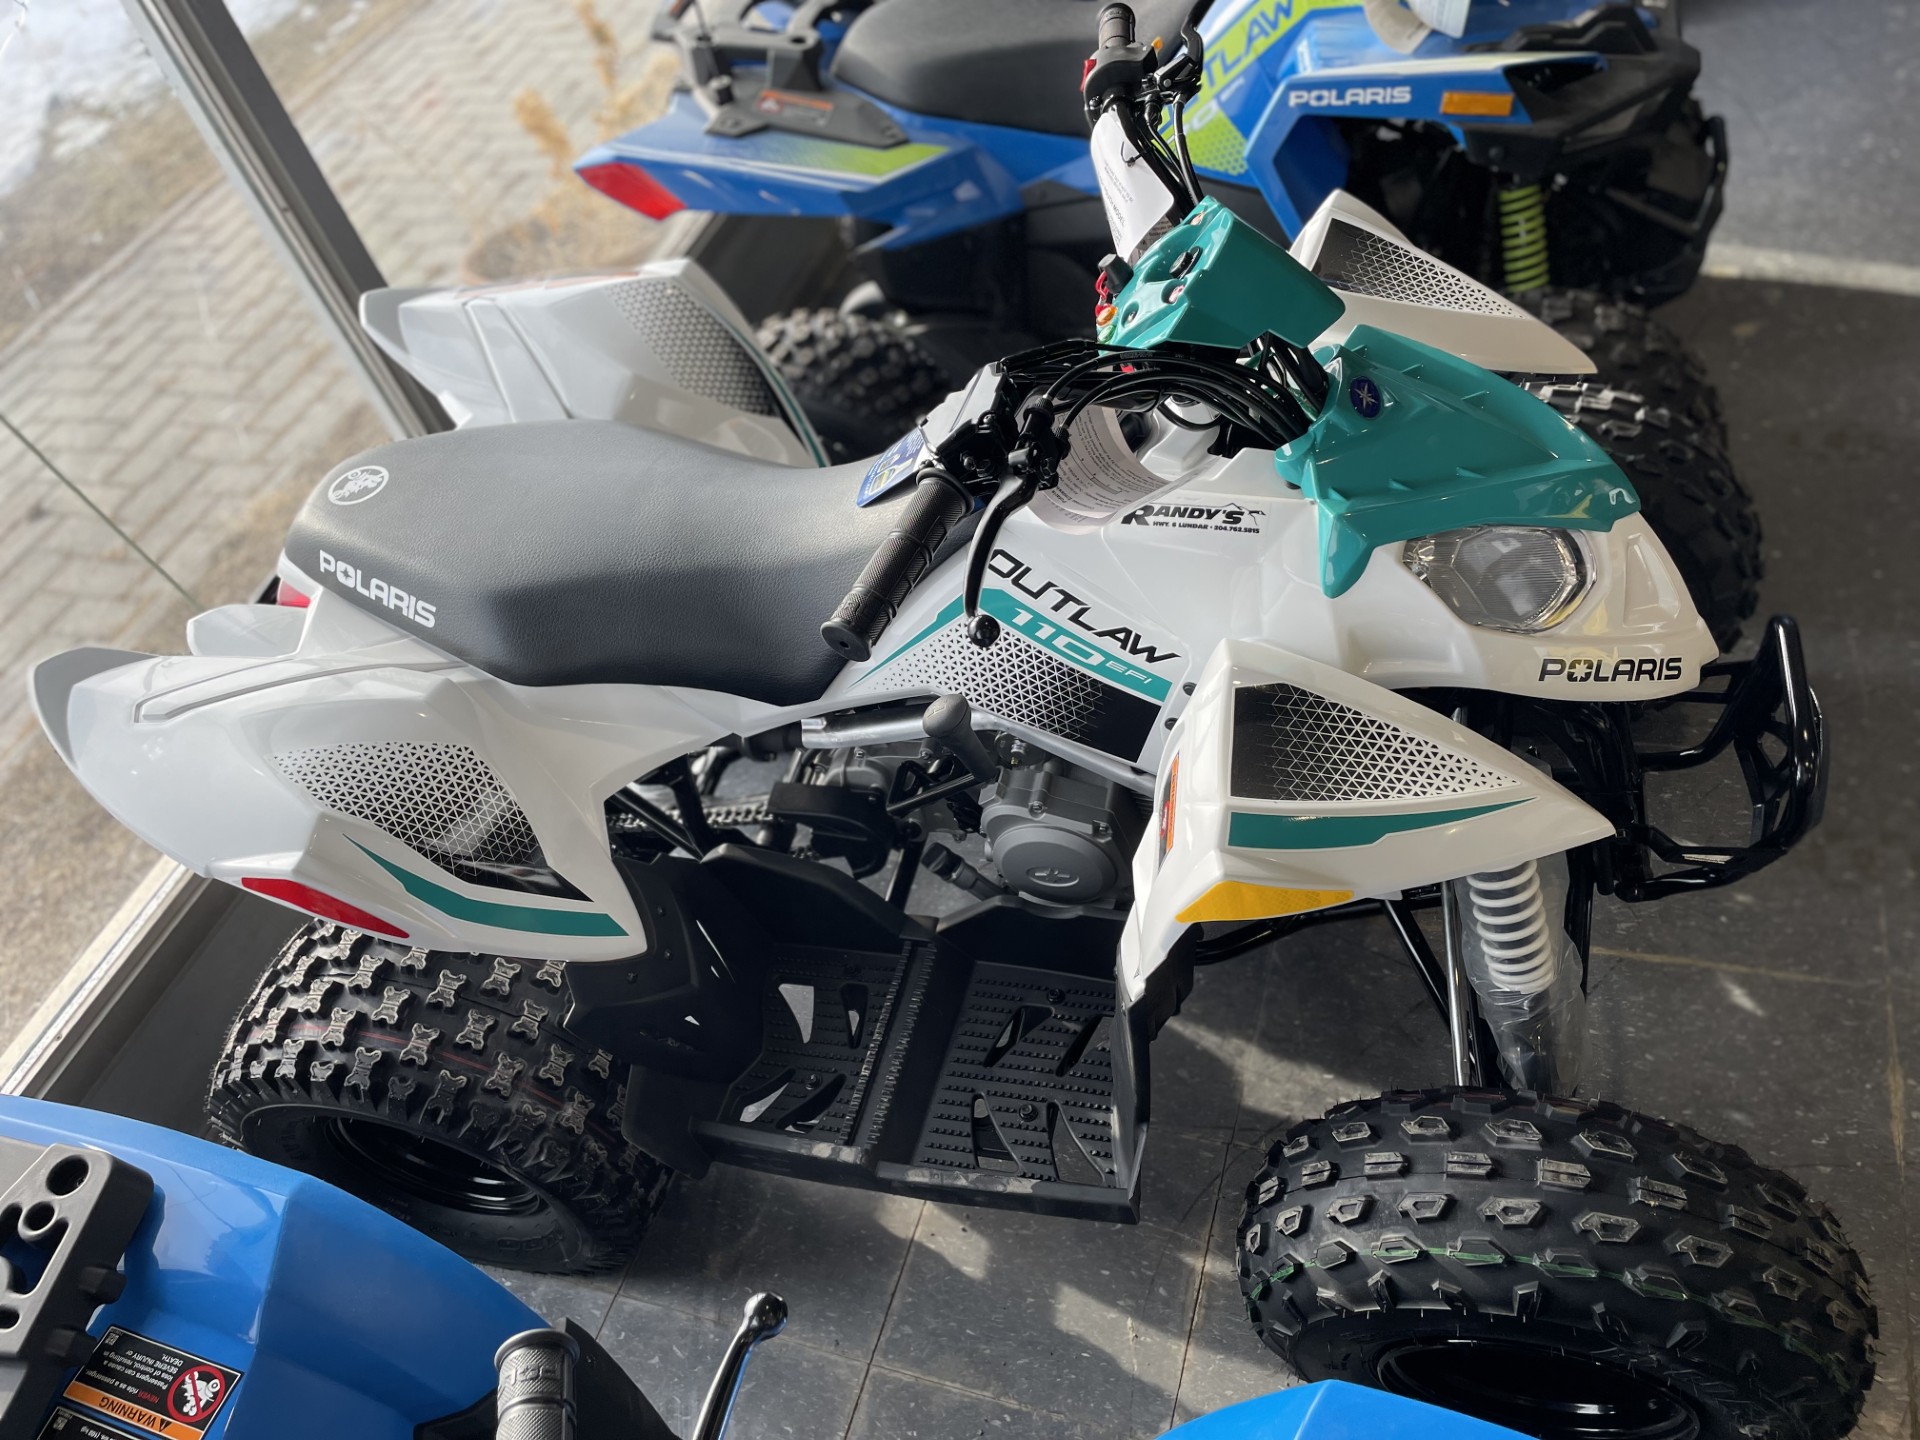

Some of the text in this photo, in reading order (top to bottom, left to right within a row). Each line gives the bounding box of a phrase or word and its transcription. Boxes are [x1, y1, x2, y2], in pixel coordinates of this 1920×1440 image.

[1288, 86, 1412, 108] POLARIS
[1121, 504, 1246, 526] RANDY'S
[1178, 522, 1209, 530] LUNDAR
[319, 549, 437, 628] POLARIS
[987, 548, 1182, 664] OUTLAW
[1011, 607, 1153, 684] 110 EFI
[1538, 657, 1682, 683] POLARIS
[132, 1352, 155, 1366] INJURY
[153, 1360, 179, 1374] SEVERE
[161, 1353, 184, 1367] DEATH.
[126, 1384, 140, 1395] ride
[135, 1372, 168, 1390] Passengers
[137, 1390, 160, 1404] NEVER
[99, 1396, 157, 1429] WARNING
